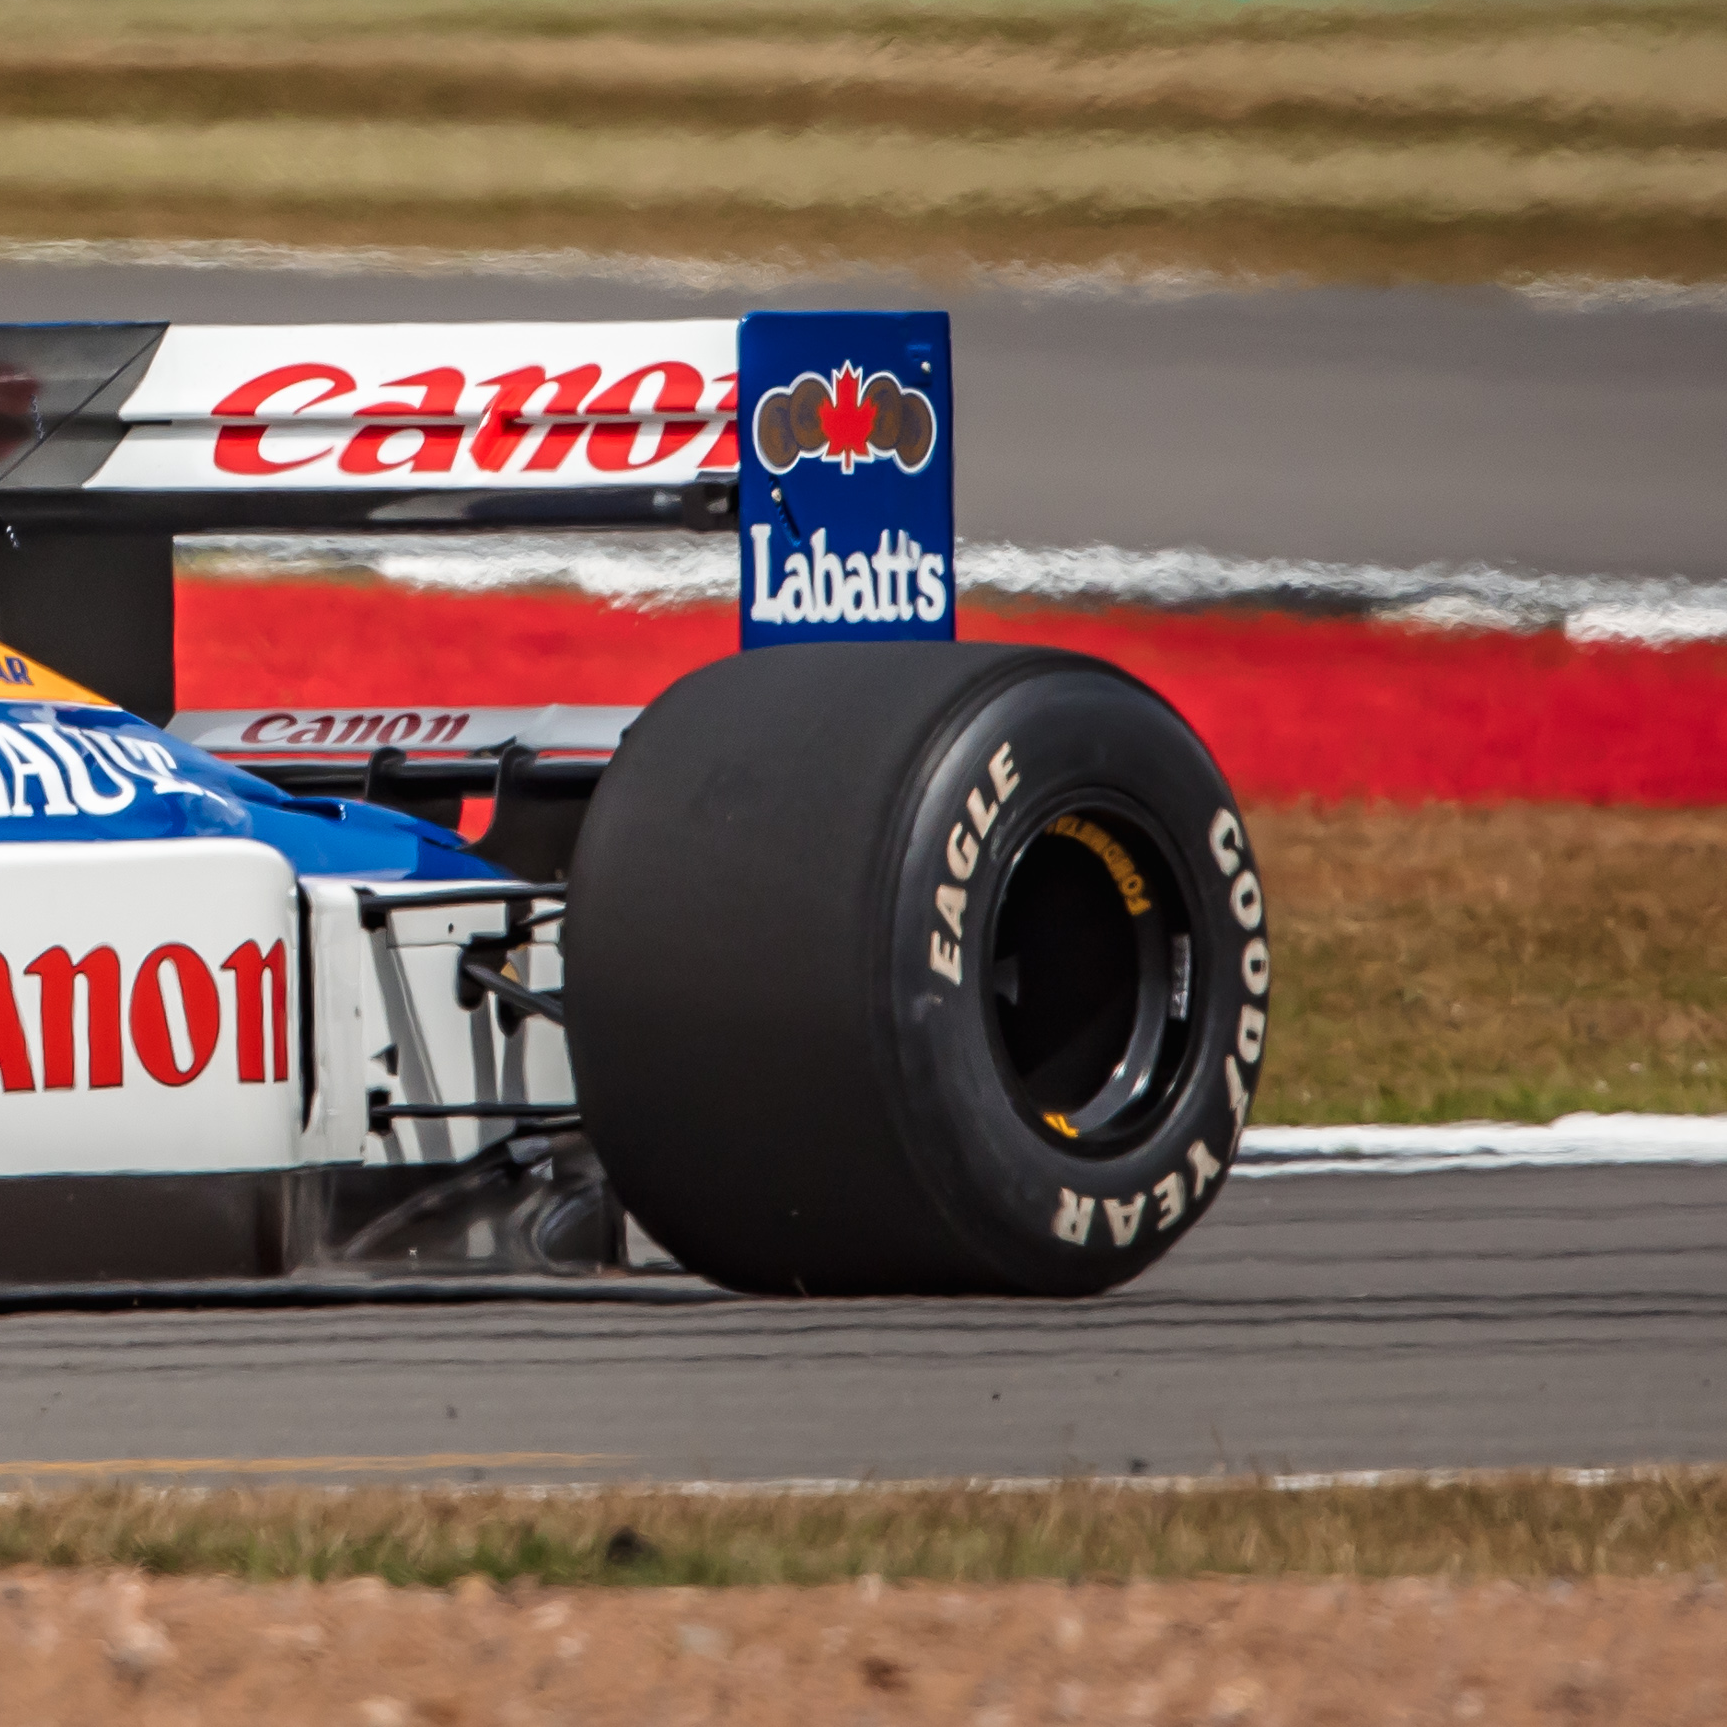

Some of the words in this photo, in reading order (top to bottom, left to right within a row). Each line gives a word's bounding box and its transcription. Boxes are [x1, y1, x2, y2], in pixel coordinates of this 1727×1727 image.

[751, 525, 946, 625] Labatt's
[241, 712, 470, 744] Canon
[930, 741, 1021, 986] EAGLE
